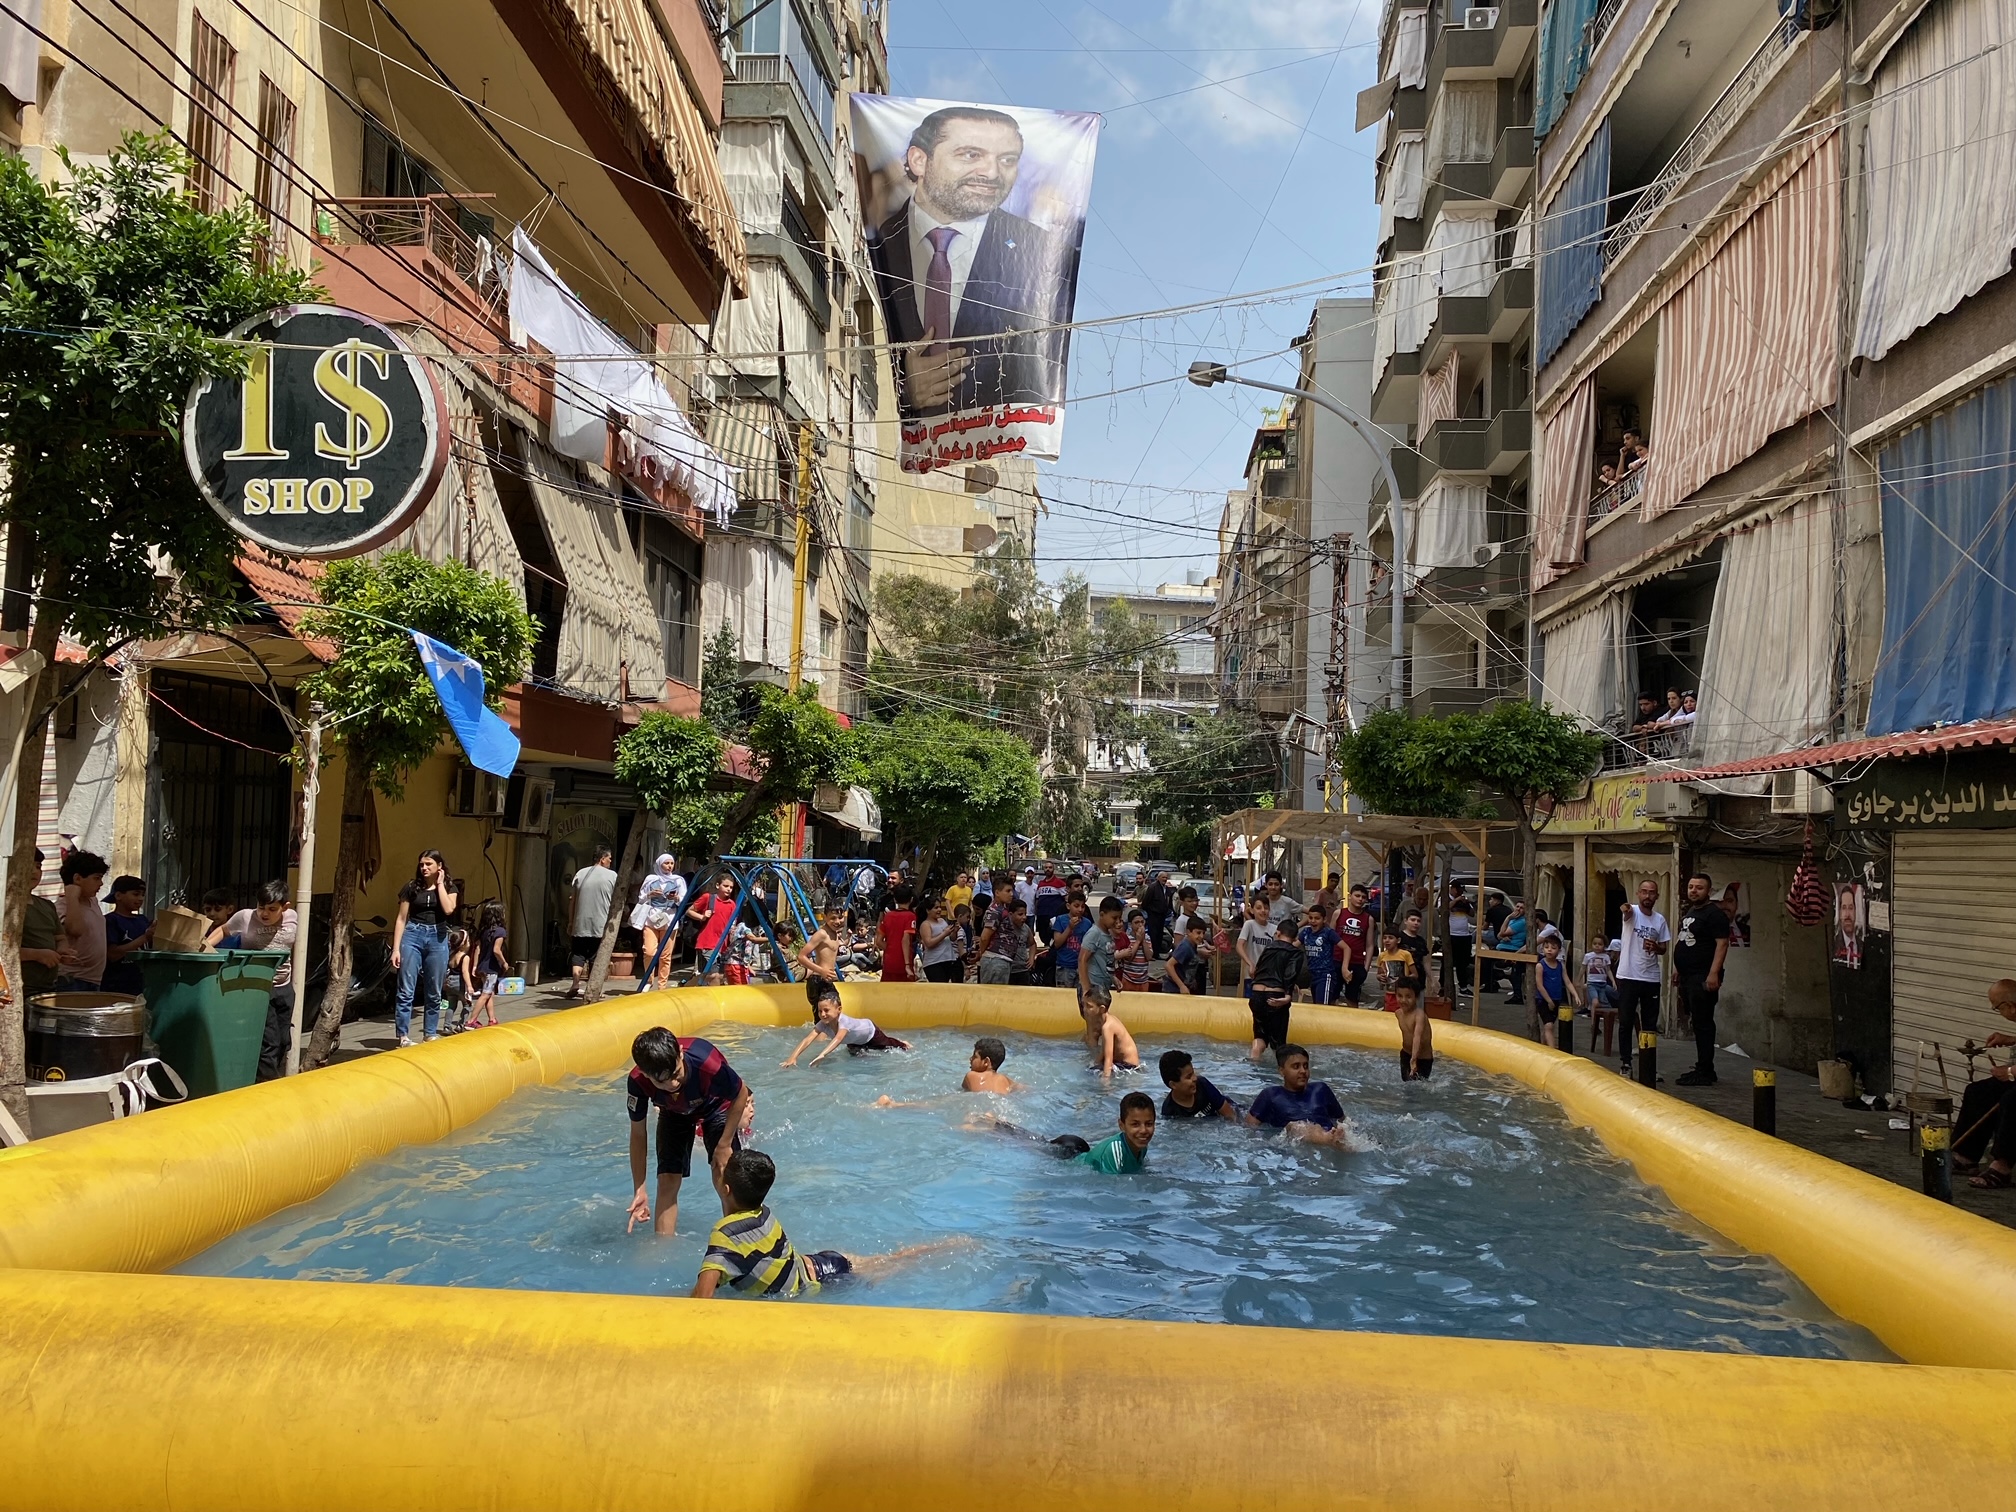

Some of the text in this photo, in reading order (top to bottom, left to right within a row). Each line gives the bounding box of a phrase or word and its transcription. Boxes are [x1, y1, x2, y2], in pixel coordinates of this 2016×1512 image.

[929, 405, 994, 445] السياسي
[995, 403, 1056, 428] العمل
[935, 441, 974, 469] دخول
[976, 435, 1027, 461] ممنوع
[243, 477, 374, 515] SHOP
[1847, 788, 1918, 825] برجاوي
[1920, 782, 1985, 824] الدين
